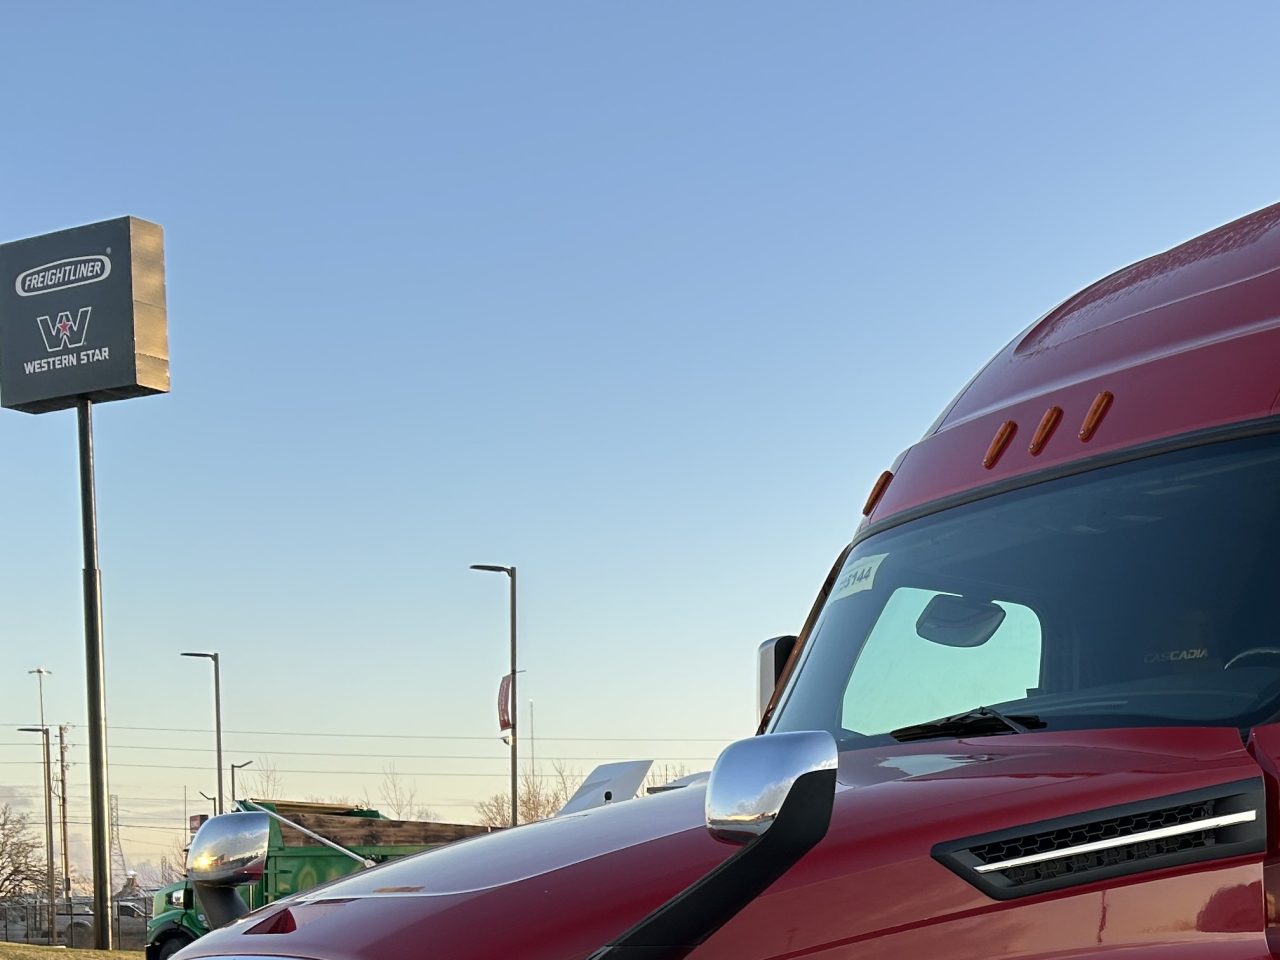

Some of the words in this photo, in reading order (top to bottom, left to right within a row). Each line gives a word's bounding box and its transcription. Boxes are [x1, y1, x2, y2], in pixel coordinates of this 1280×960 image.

[25, 261, 102, 290] FREIGHTLINER
[24, 353, 77, 374] WESTERN
[80, 347, 109, 364] STAR
[1143, 648, 1208, 663] CASCADIA
